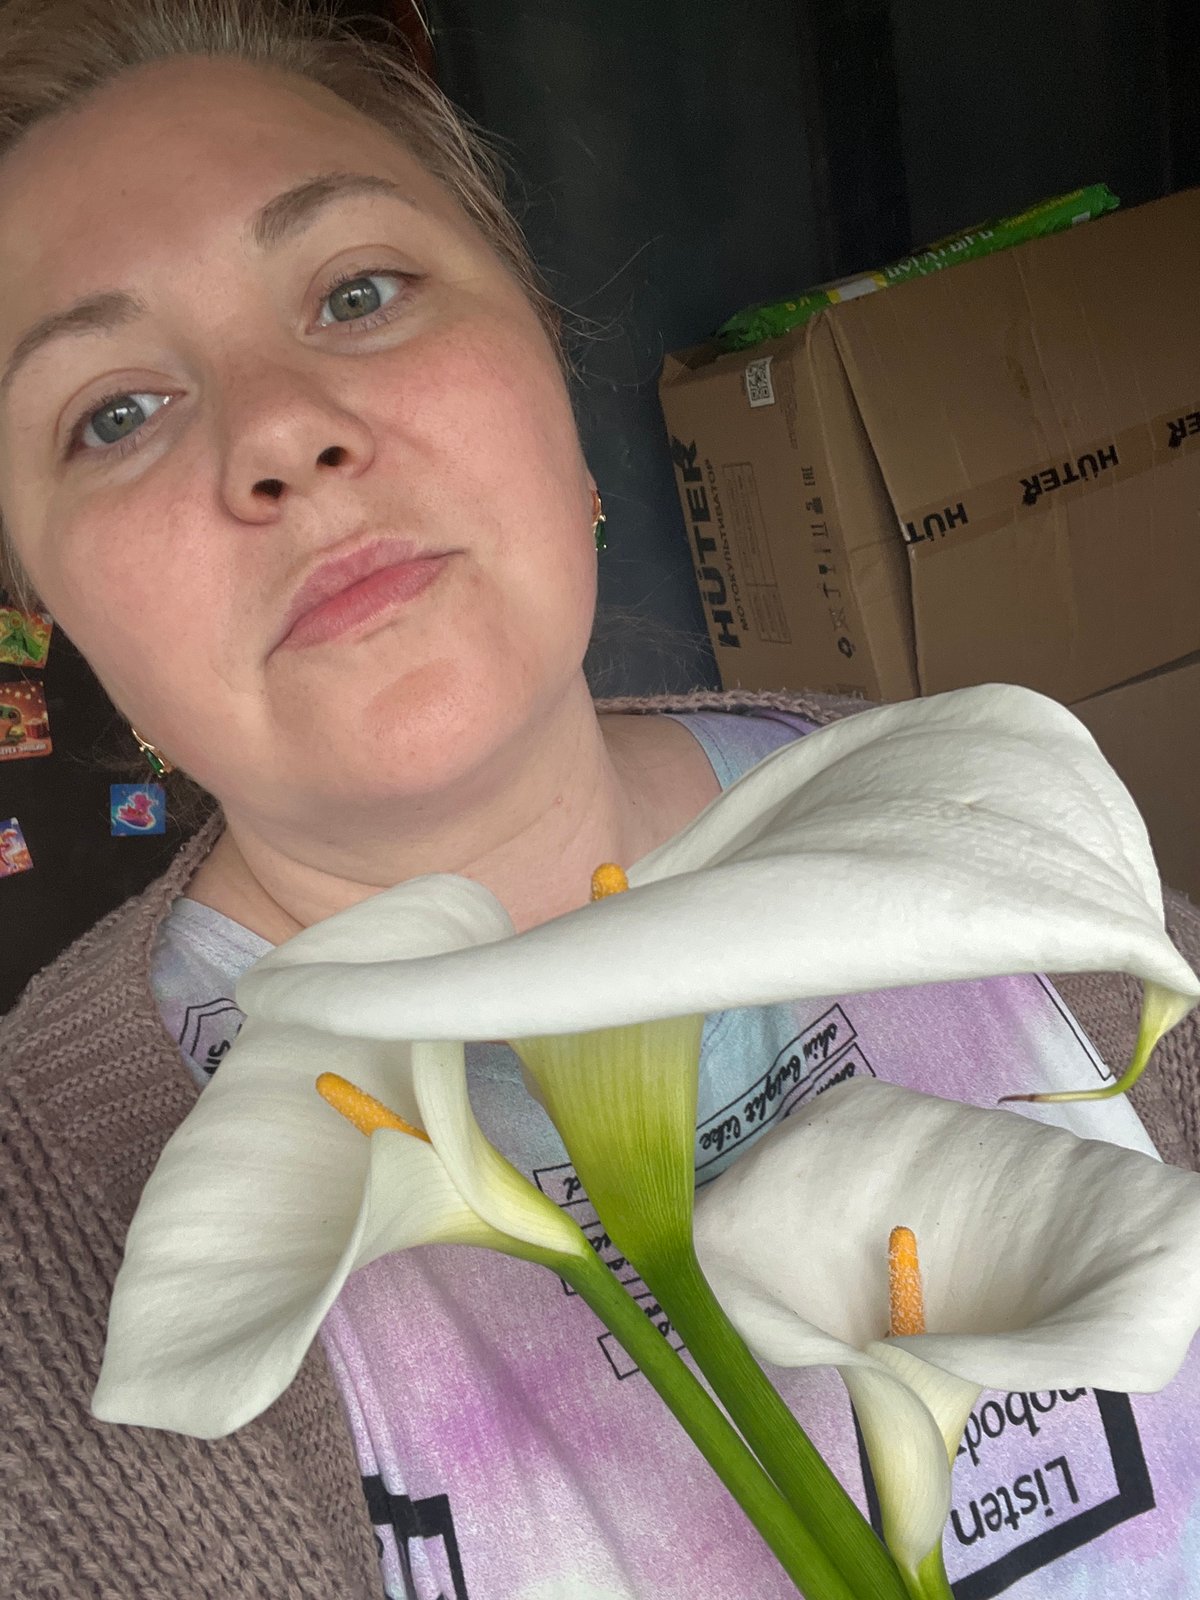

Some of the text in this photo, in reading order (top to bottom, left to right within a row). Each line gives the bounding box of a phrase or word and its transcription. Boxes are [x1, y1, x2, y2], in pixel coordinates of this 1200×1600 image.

[1019, 444, 1119, 506] HÜTER
[671, 434, 742, 649] HÜTER
[905, 502, 969, 545] HÜT
[698, 1114, 742, 1152] like
[949, 1455, 1081, 1546] Listen
